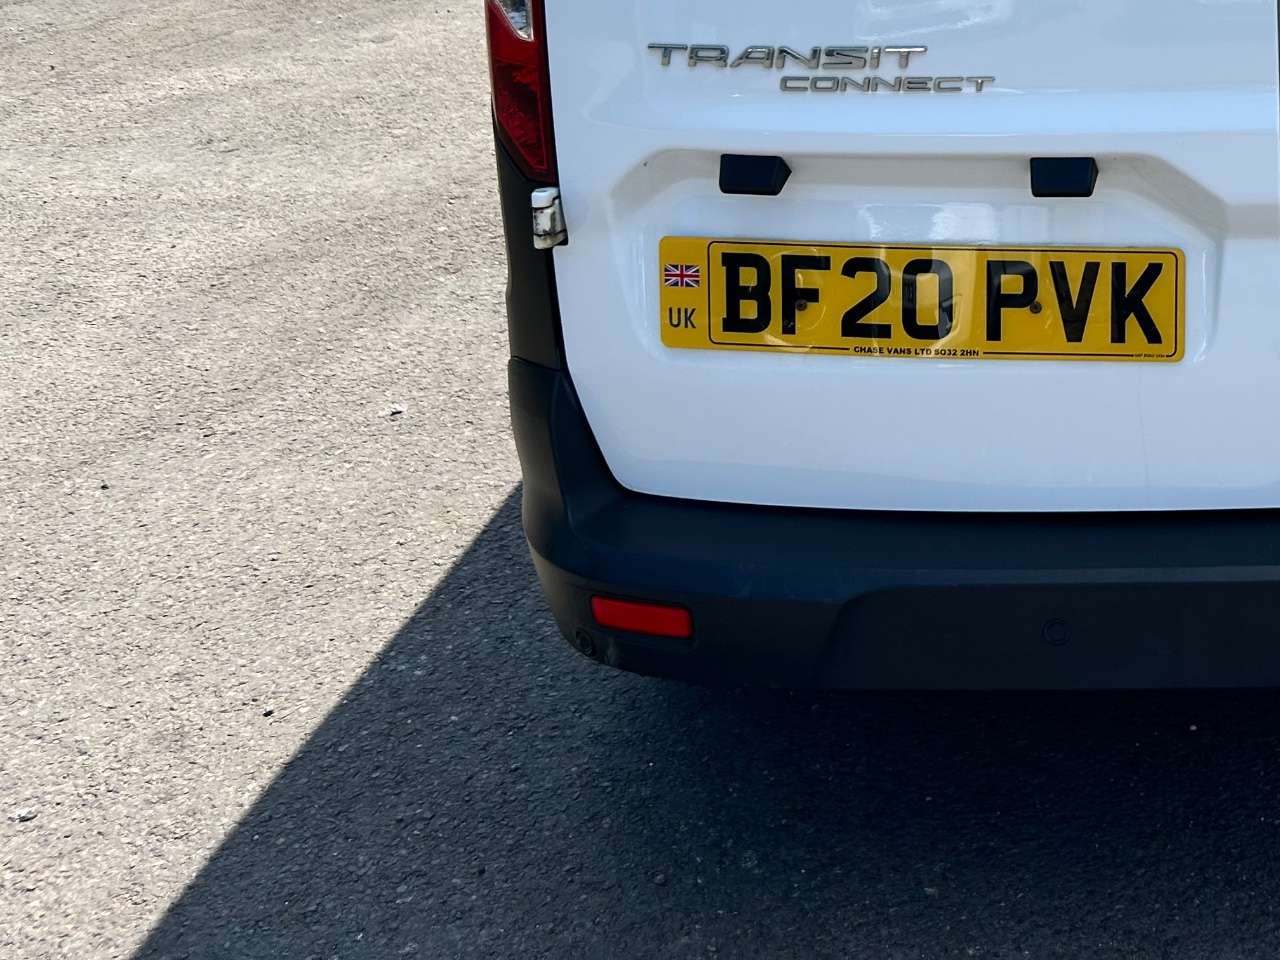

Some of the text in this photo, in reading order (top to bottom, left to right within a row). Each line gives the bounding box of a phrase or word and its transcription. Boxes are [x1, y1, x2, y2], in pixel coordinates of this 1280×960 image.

[648, 43, 928, 69] TRANSIT
[779, 75, 995, 92] CONNECT
[721, 251, 1165, 344] BF20 PVK
[669, 306, 697, 329] UK
[853, 345, 980, 357] CHASE VANS LTD SO32 2HN
